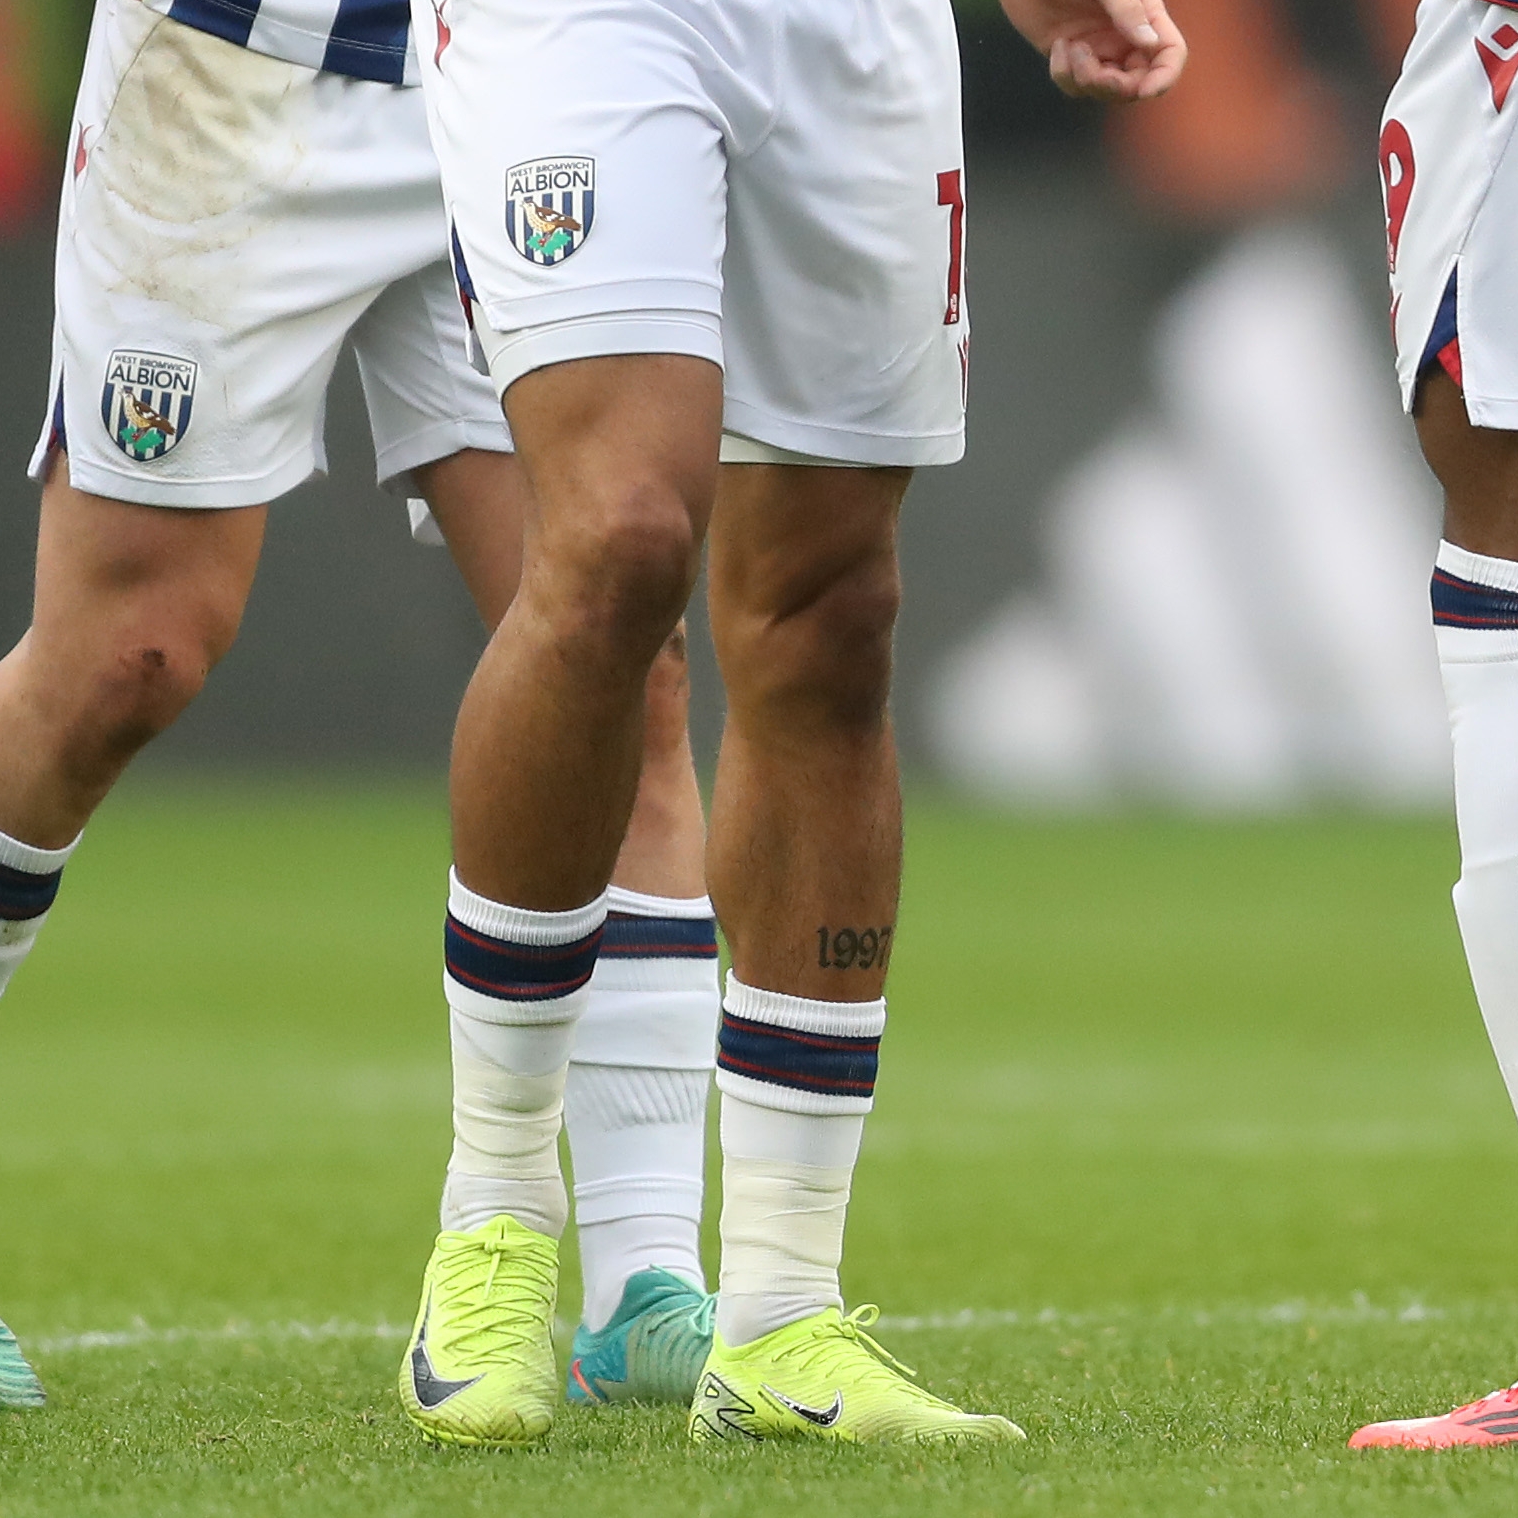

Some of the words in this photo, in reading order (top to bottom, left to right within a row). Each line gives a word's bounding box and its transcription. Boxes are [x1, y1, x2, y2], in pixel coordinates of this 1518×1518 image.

[510, 166, 533, 178] WEST
[536, 161, 589, 173] BROMWICH
[510, 170, 589, 197] ALBION
[115, 355, 137, 365] WEST
[139, 358, 192, 373] BROMWICH
[110, 363, 191, 392] ALBION
